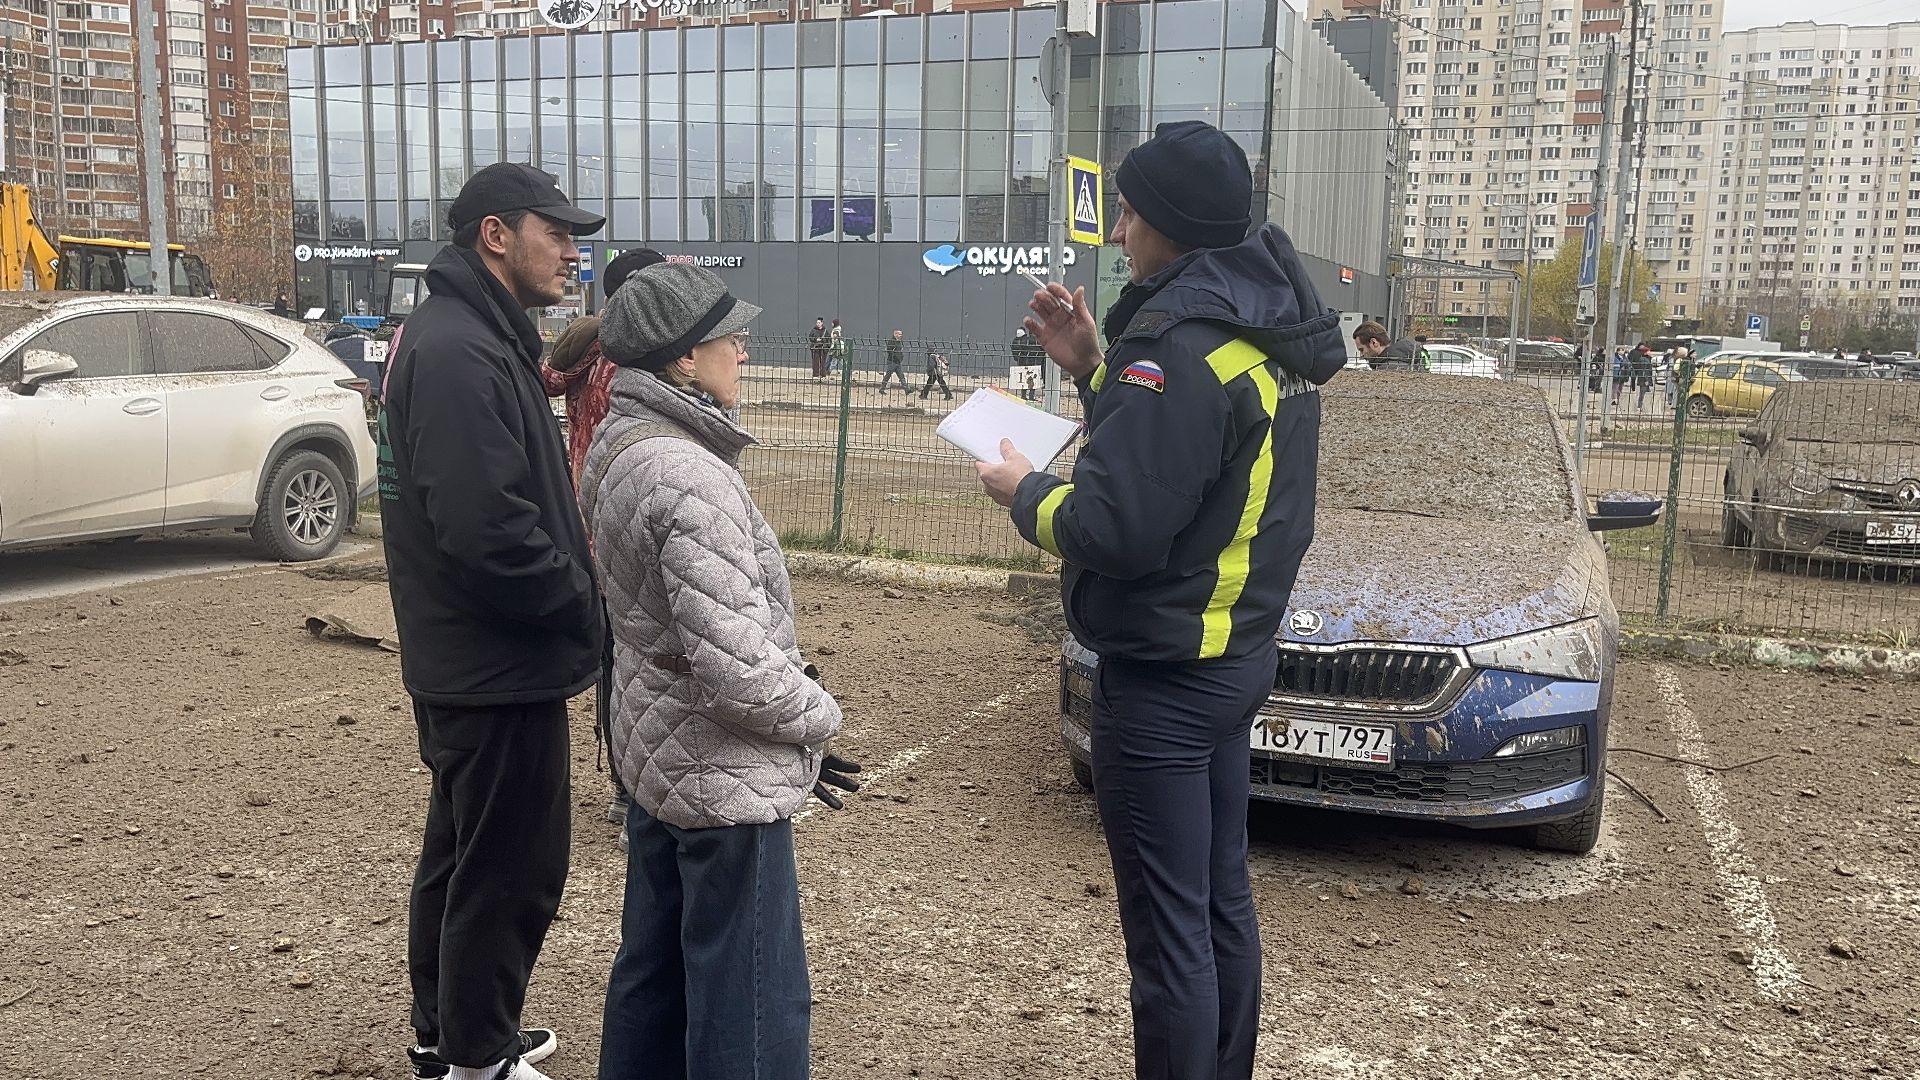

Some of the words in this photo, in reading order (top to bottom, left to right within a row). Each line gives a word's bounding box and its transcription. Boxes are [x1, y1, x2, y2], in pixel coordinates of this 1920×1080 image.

[977, 266, 996, 276] три
[1016, 265, 1067, 275] бассе
[1750, 316, 1761, 328] P
[1127, 374, 1157, 388] РОССИЯ
[1338, 725, 1385, 750] 797
[1347, 750, 1370, 759] RUS
